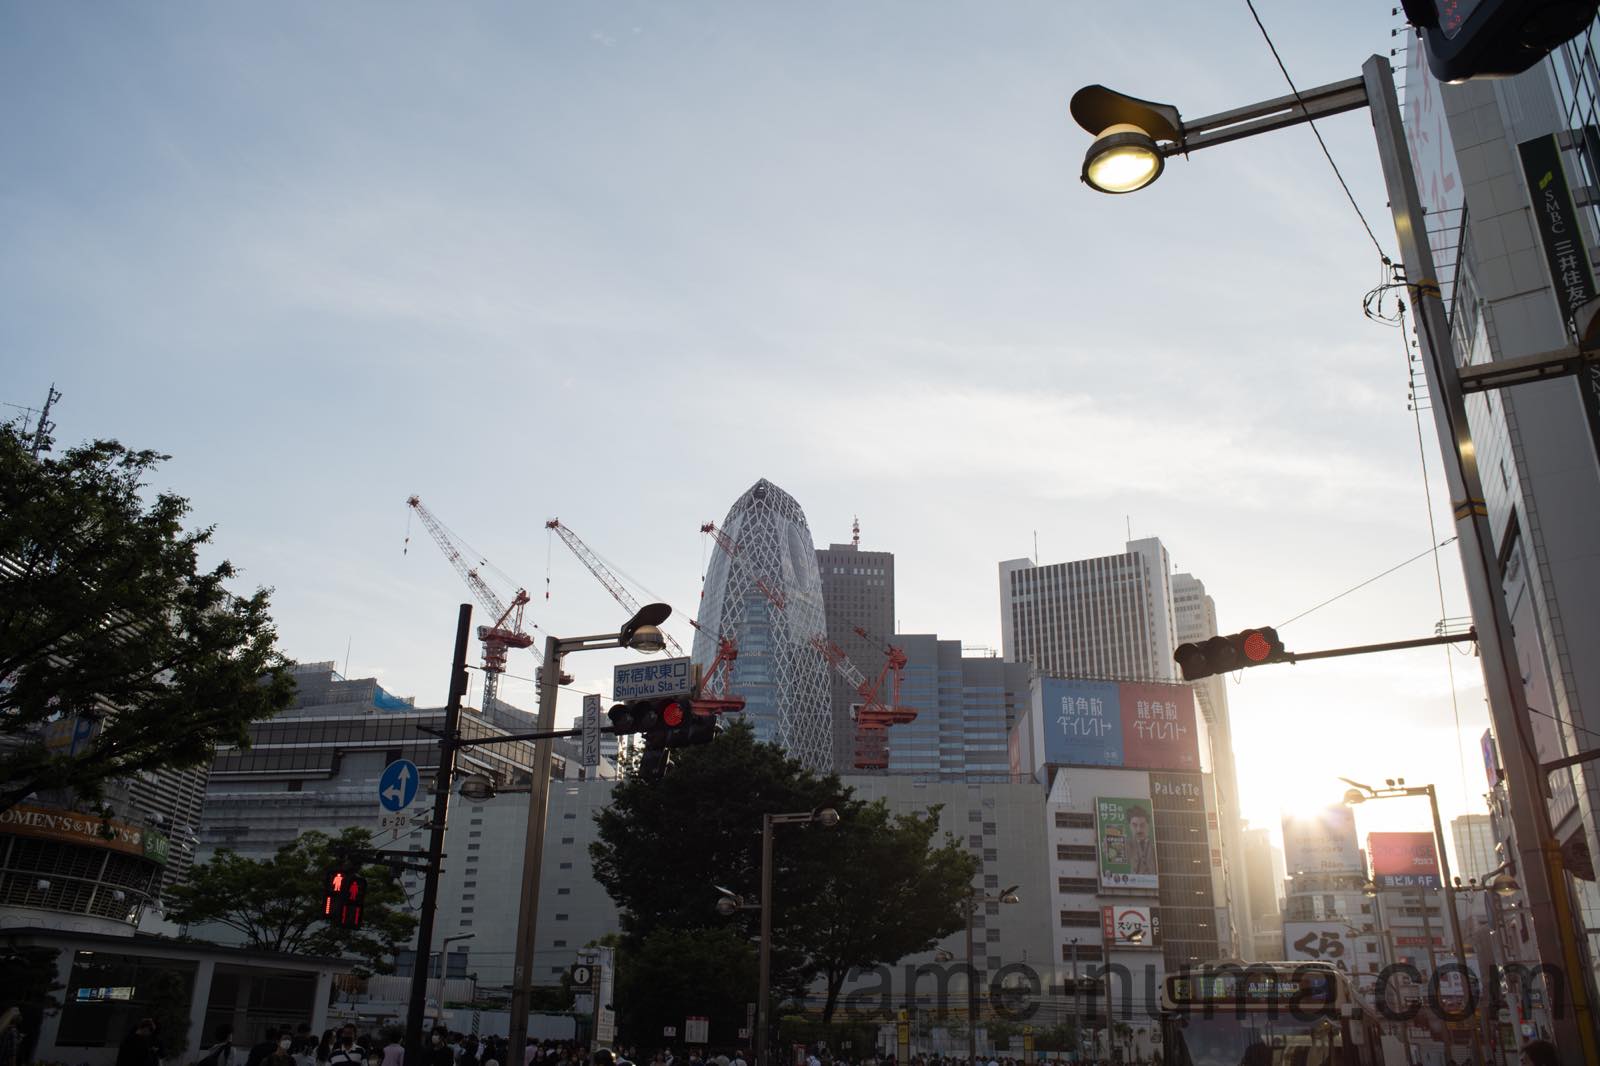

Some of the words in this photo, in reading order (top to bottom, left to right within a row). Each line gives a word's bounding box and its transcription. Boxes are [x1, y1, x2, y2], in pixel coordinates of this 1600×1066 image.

[1544, 189, 1566, 234] SMBC
[616, 662, 687, 685] 新宿駅東口
[616, 683, 655, 697] Shinjuku
[1060, 696, 1104, 716] 龍角散
[1136, 700, 1178, 720] 龍角散
[585, 697, 597, 763] スクランブル式
[1056, 716, 1112, 737] ダイレクト
[1132, 720, 1187, 740] ダイレクト
[0, 808, 73, 832] OMEN'S
[1384, 875, 1414, 886] 当ビル
[1117, 921, 1149, 930] スシロー
[1294, 931, 1345, 958] くら
